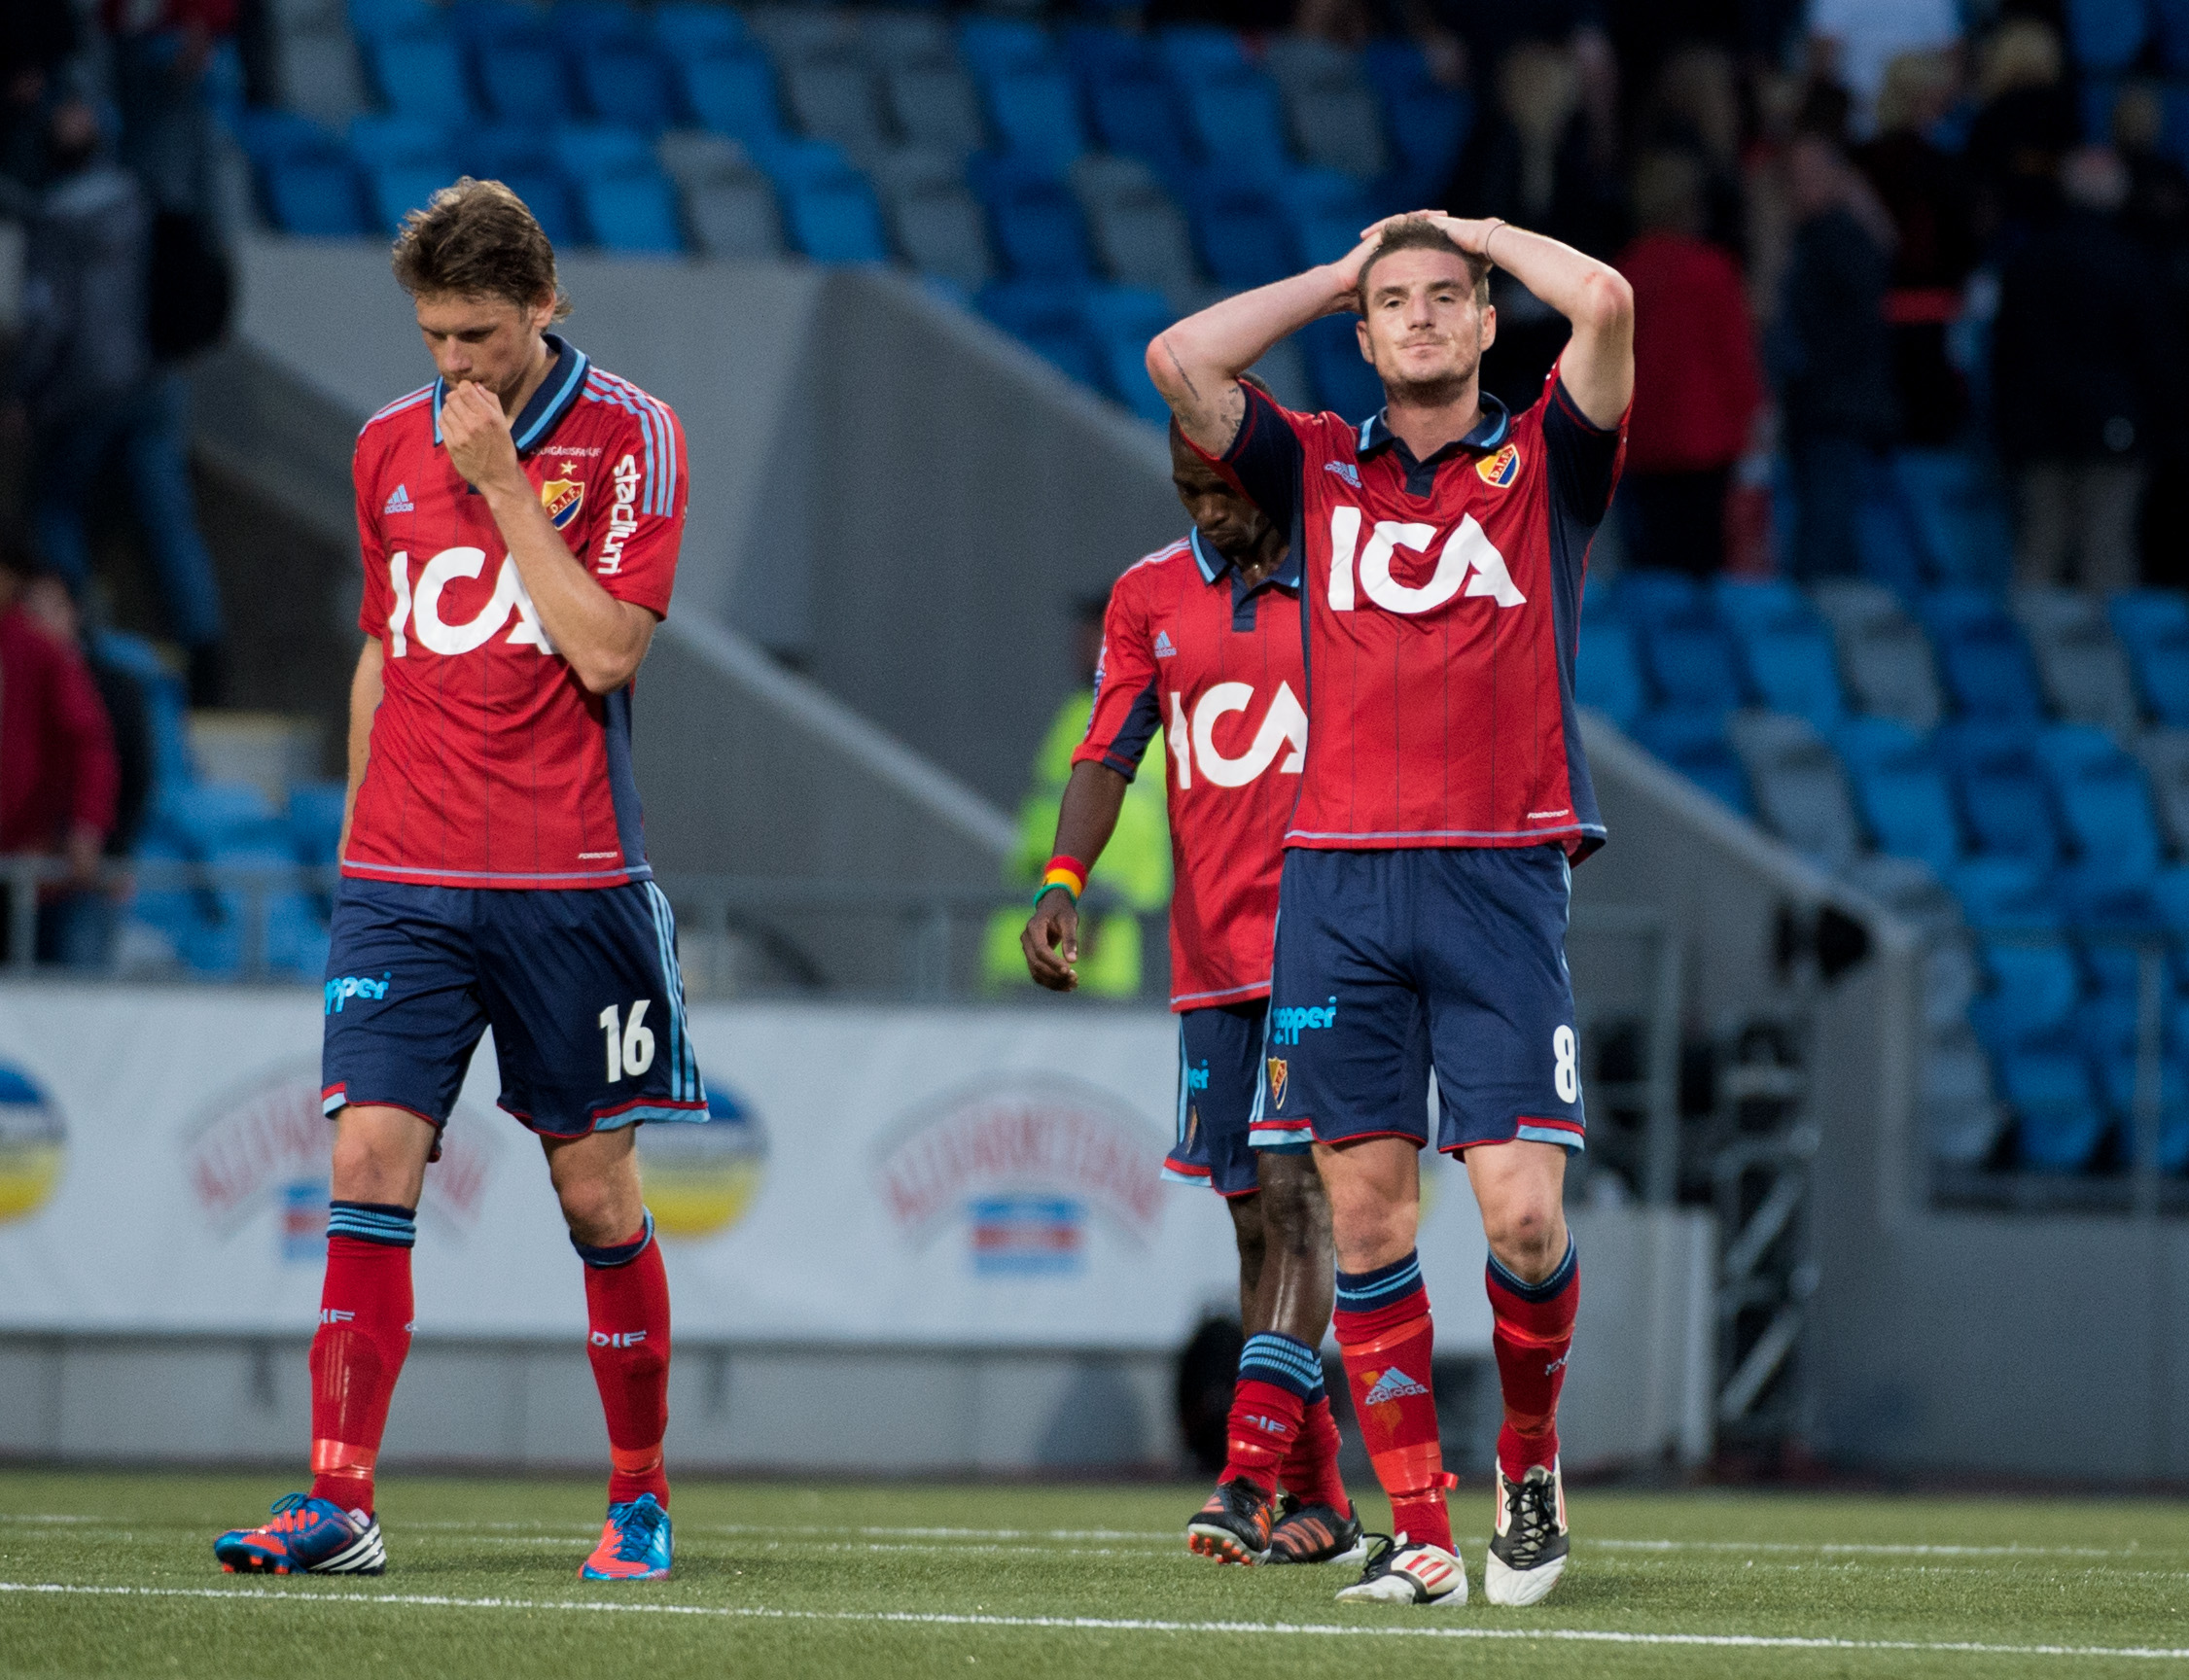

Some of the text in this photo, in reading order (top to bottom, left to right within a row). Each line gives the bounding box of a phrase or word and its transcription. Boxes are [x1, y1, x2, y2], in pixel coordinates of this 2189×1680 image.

[384, 503, 414, 515] adidas
[598, 454, 641, 575] stadium
[1327, 506, 1528, 613] ICA
[389, 546, 553, 658] ICA
[1169, 680, 1309, 789] ICA
[599, 999, 655, 1084] 16
[1553, 1024, 1577, 1103] 8
[319, 1308, 356, 1324] IF
[590, 1329, 648, 1348] DIF
[1364, 1382, 1429, 1406] adidas
